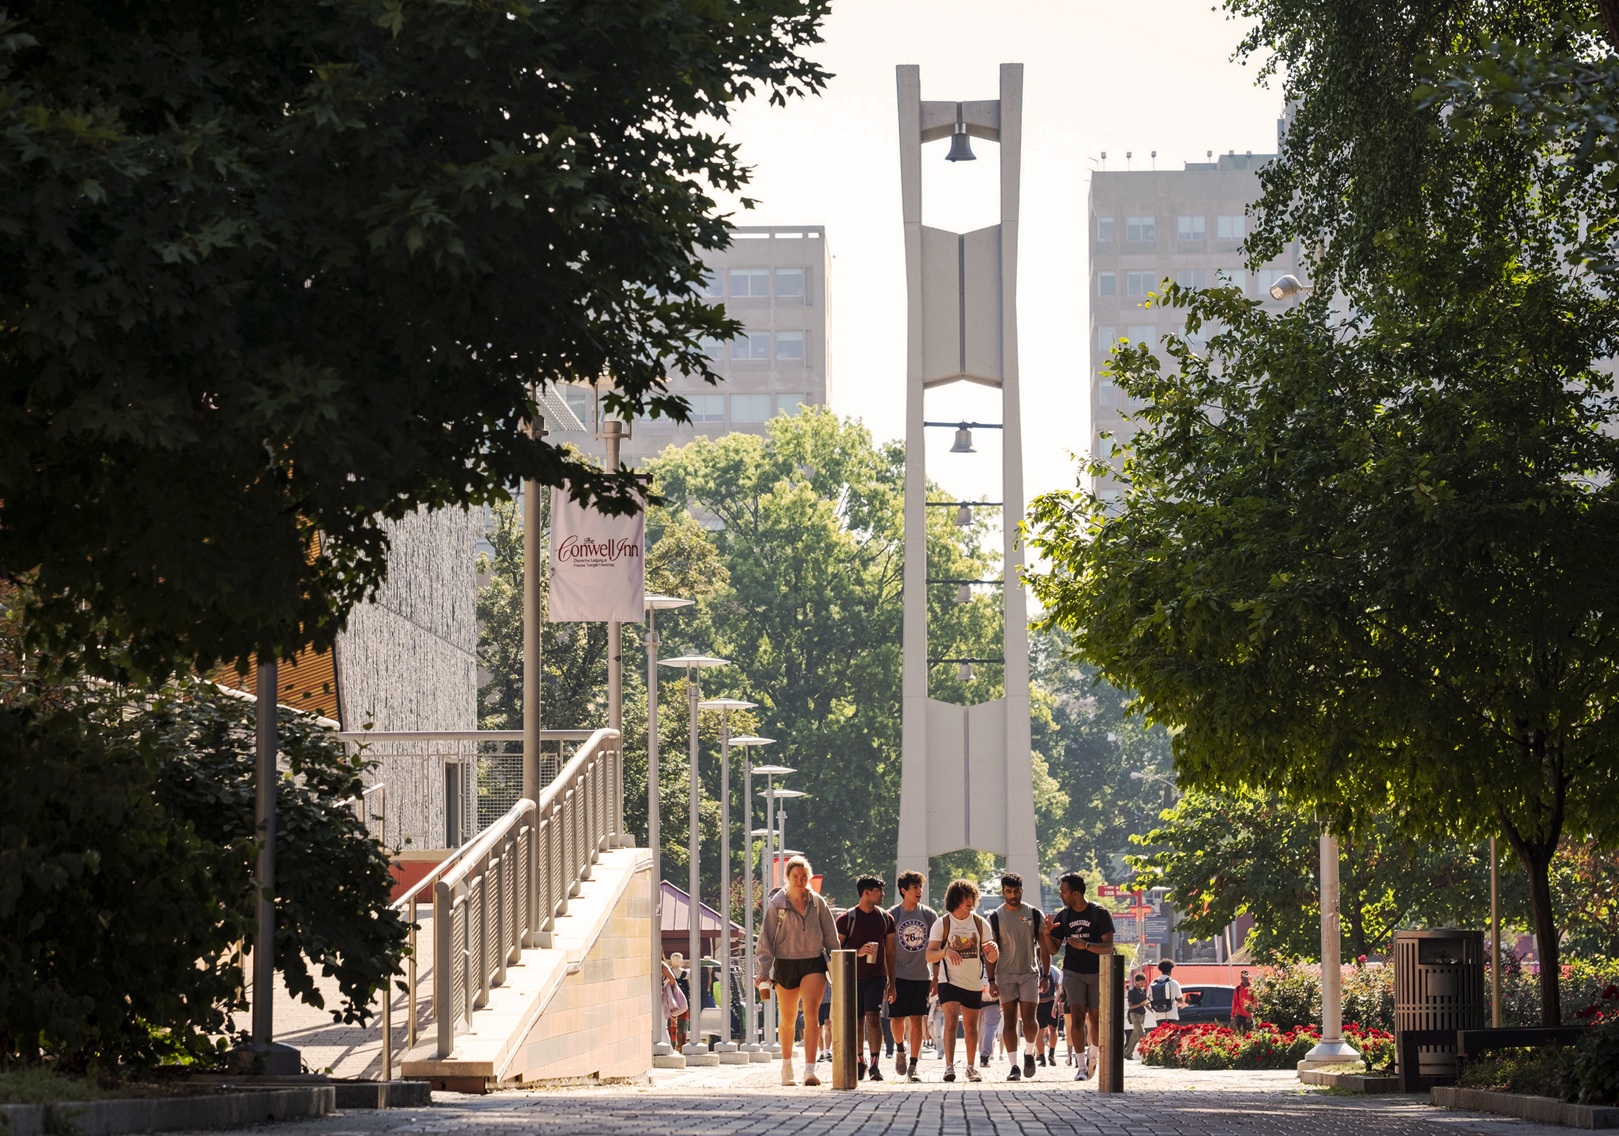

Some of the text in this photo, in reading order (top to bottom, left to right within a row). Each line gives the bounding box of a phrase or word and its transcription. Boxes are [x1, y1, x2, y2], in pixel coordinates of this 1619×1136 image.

[555, 535, 639, 562] Conwell Inn
[584, 537, 595, 545] The
